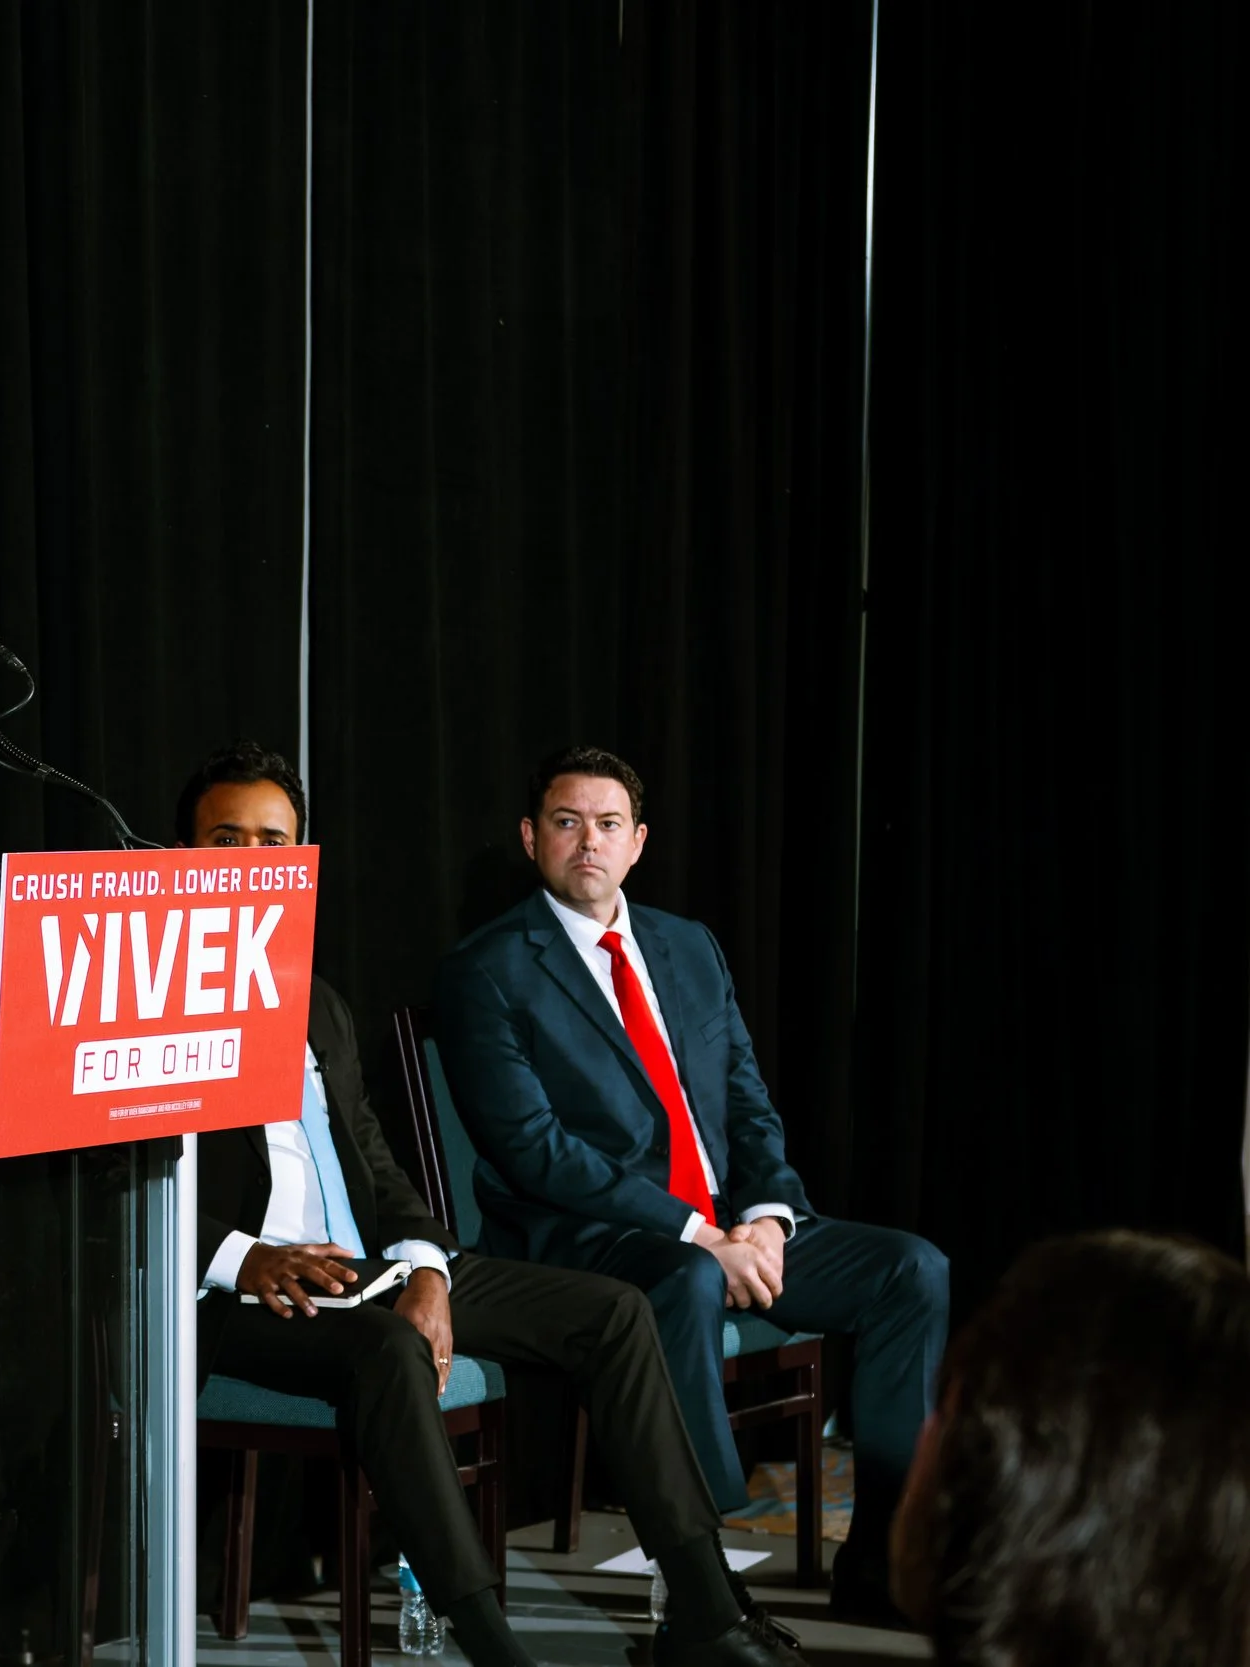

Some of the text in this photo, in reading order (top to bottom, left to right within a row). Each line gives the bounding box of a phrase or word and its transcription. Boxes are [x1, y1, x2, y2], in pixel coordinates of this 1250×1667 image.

[11, 865, 313, 901] CRUSH FRAUD. LOWER COSTS.
[40, 904, 285, 1027] VIVEK
[82, 1038, 235, 1084] FOR OHIO
